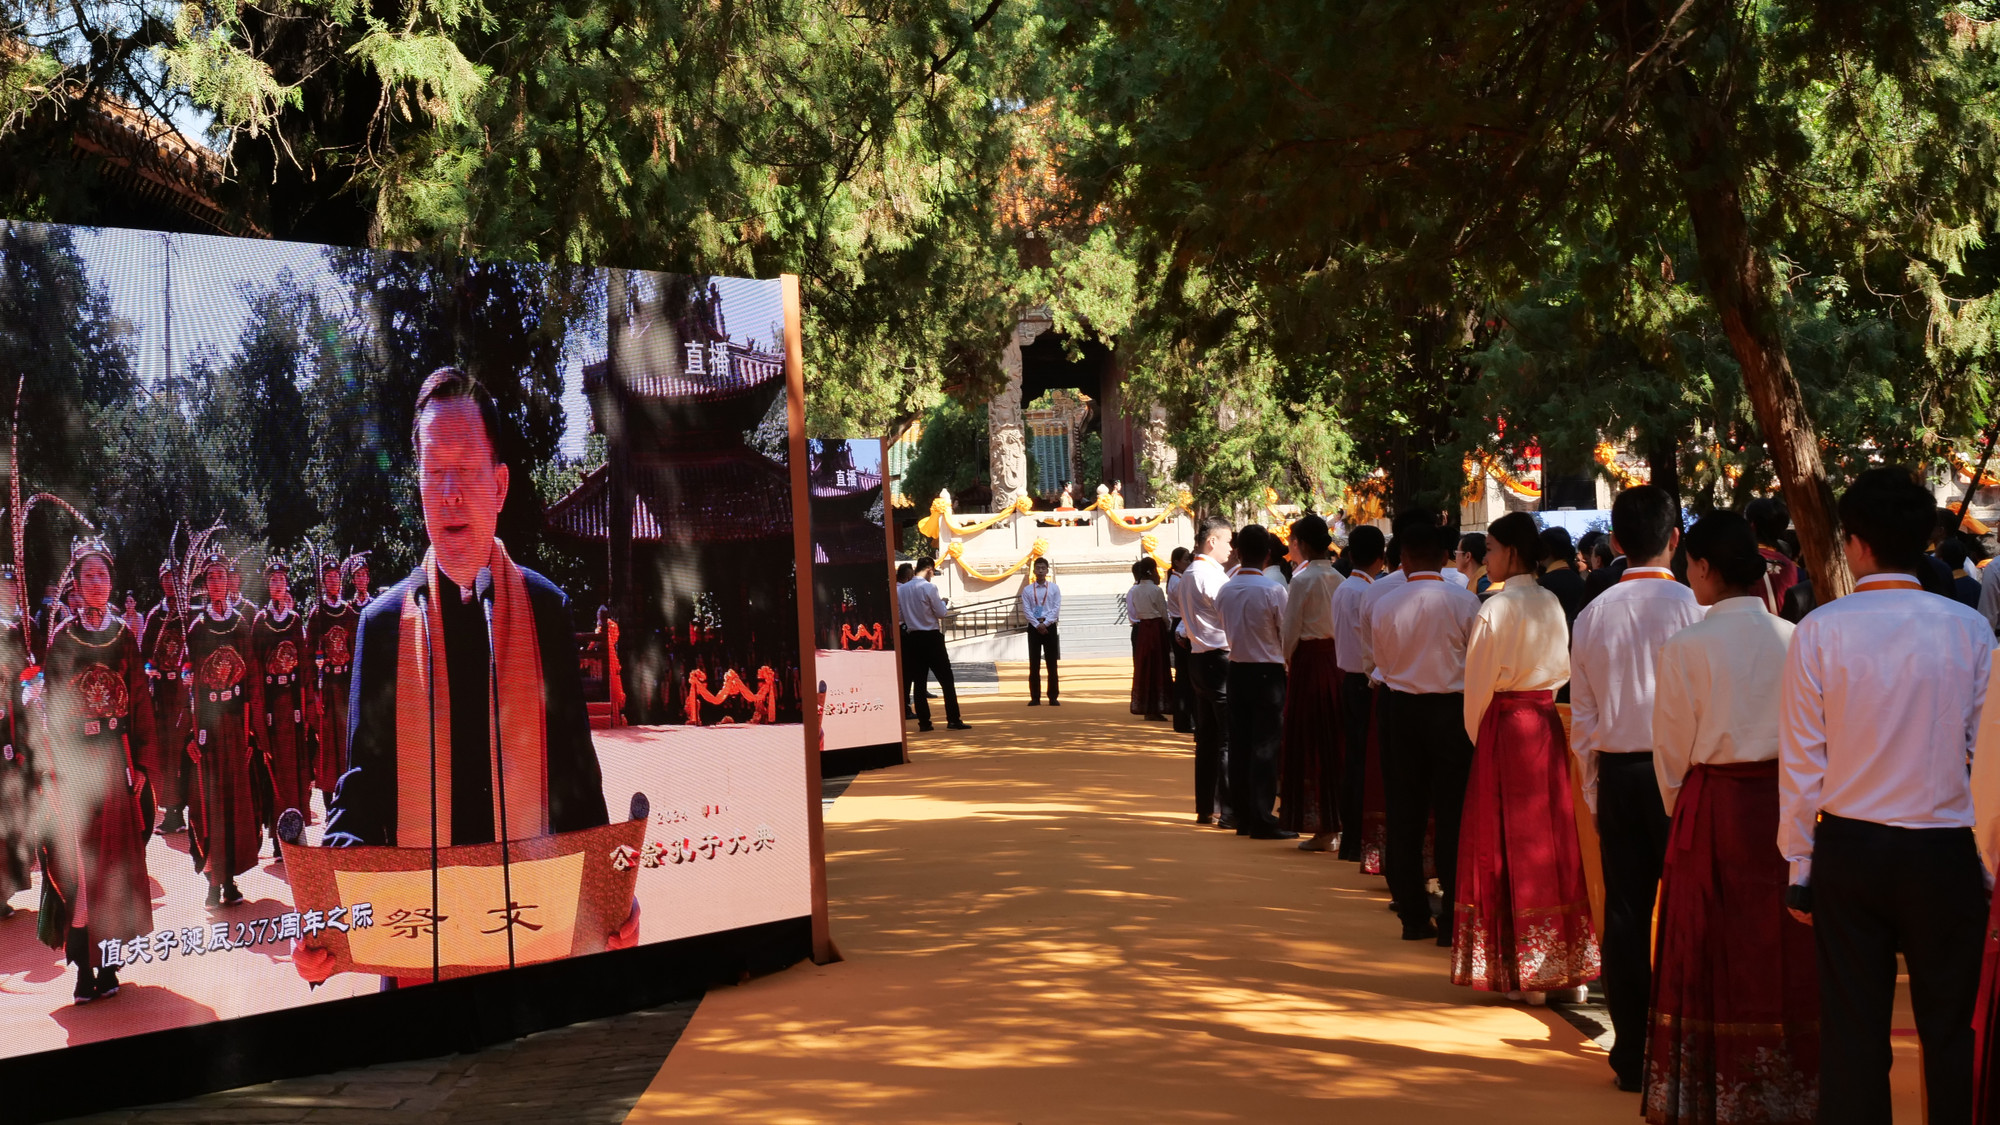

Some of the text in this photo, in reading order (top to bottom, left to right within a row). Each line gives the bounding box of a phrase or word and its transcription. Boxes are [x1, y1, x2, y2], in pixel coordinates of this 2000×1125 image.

[684, 340, 730, 376] 直播
[835, 470, 857, 487] 直播
[609, 824, 776, 872] 公祭孔子大典
[98, 902, 374, 969] 值夫子诞辰2575周年之际
